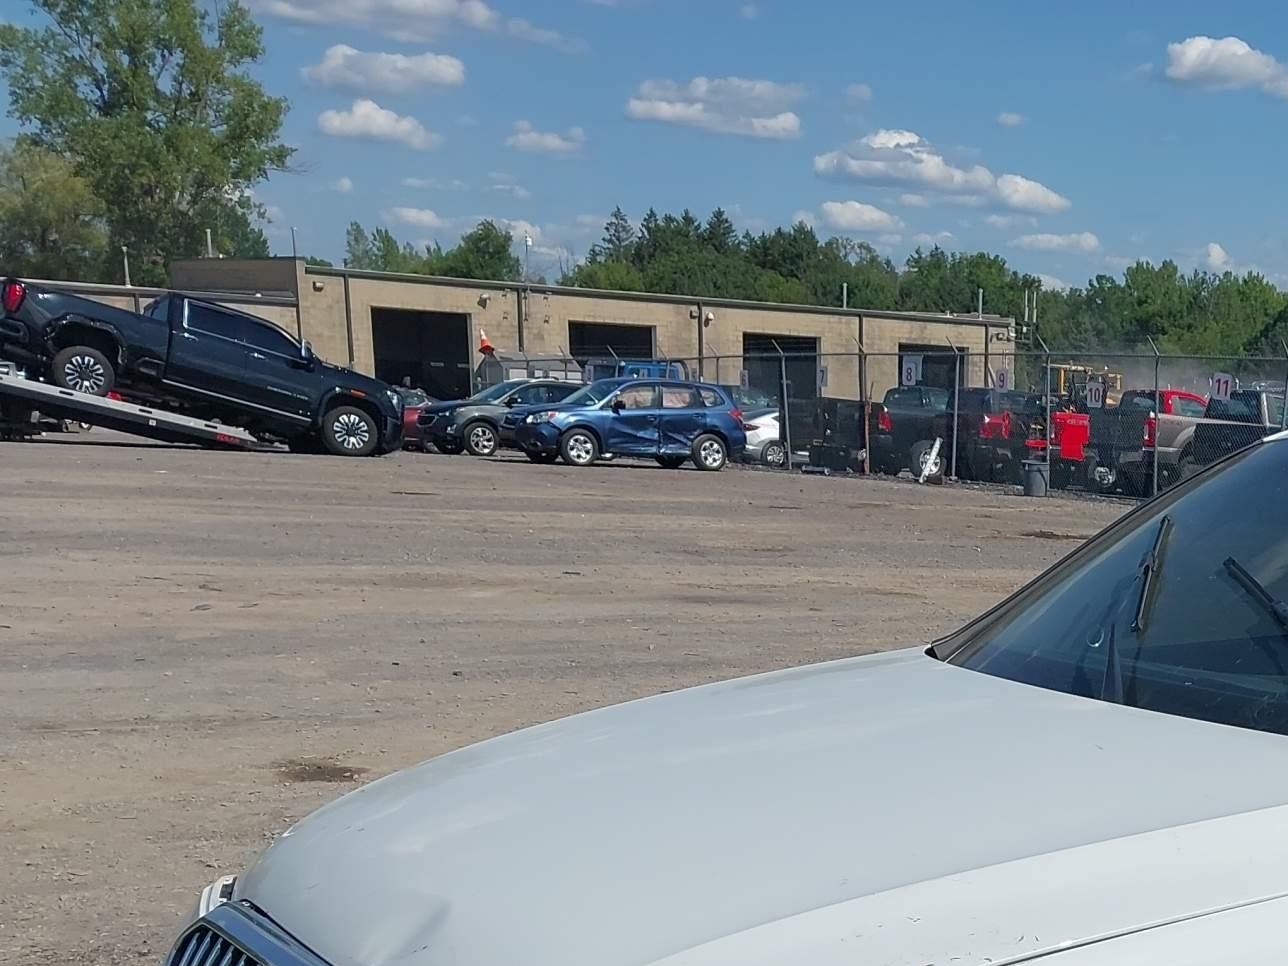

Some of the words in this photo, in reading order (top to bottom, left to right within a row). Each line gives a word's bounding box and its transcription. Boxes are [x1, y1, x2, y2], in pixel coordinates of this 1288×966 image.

[905, 367, 913, 382] 8
[998, 372, 1006, 388] 9
[1088, 387, 1101, 403] 10
[1215, 378, 1232, 397] 11
